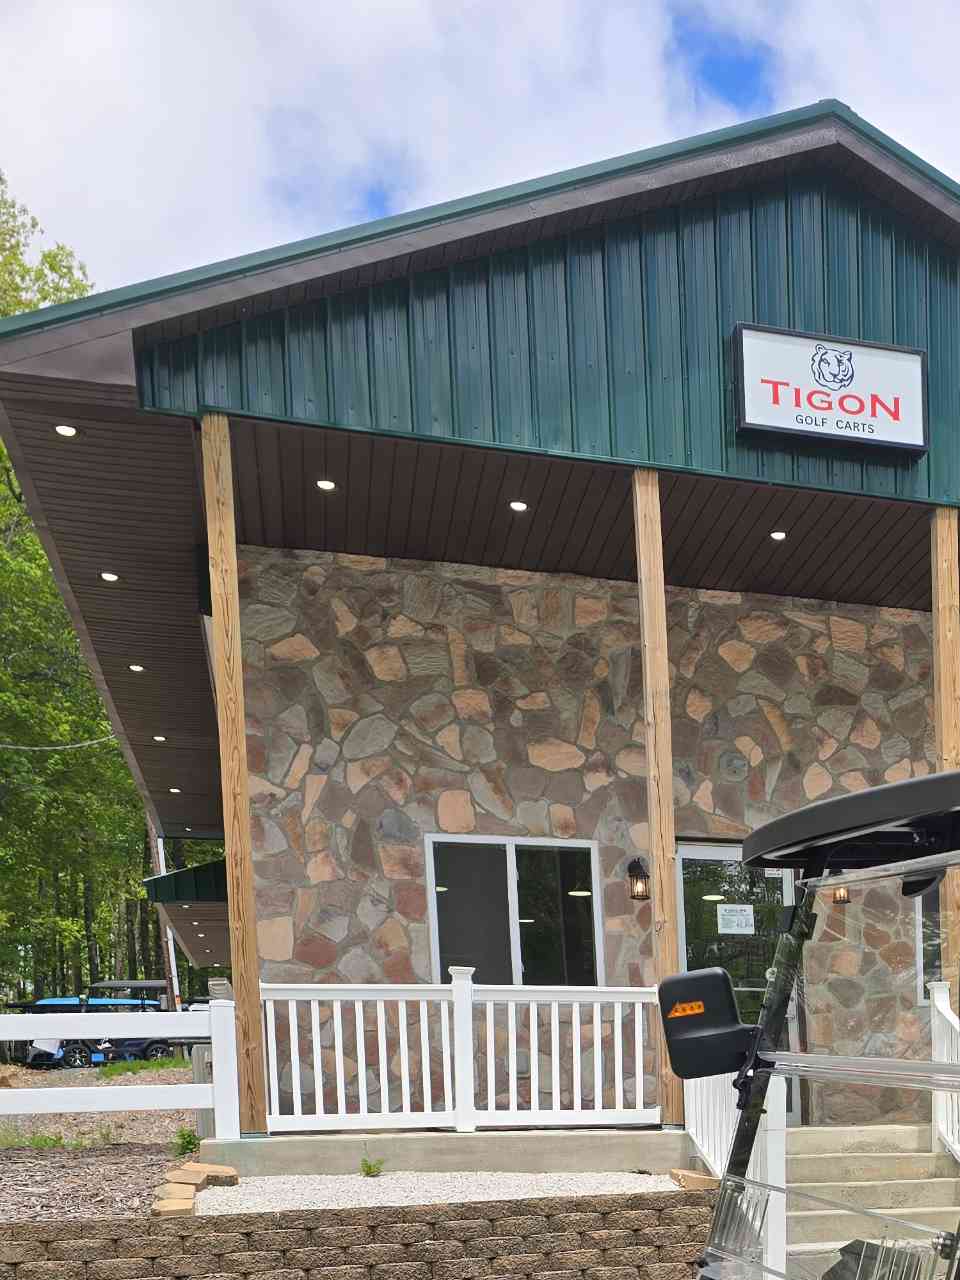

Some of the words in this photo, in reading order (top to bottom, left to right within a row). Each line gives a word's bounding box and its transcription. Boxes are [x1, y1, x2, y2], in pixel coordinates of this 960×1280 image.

[760, 379, 901, 421] TIGON
[795, 414, 828, 427] GOLF
[835, 419, 875, 434] CARTS
